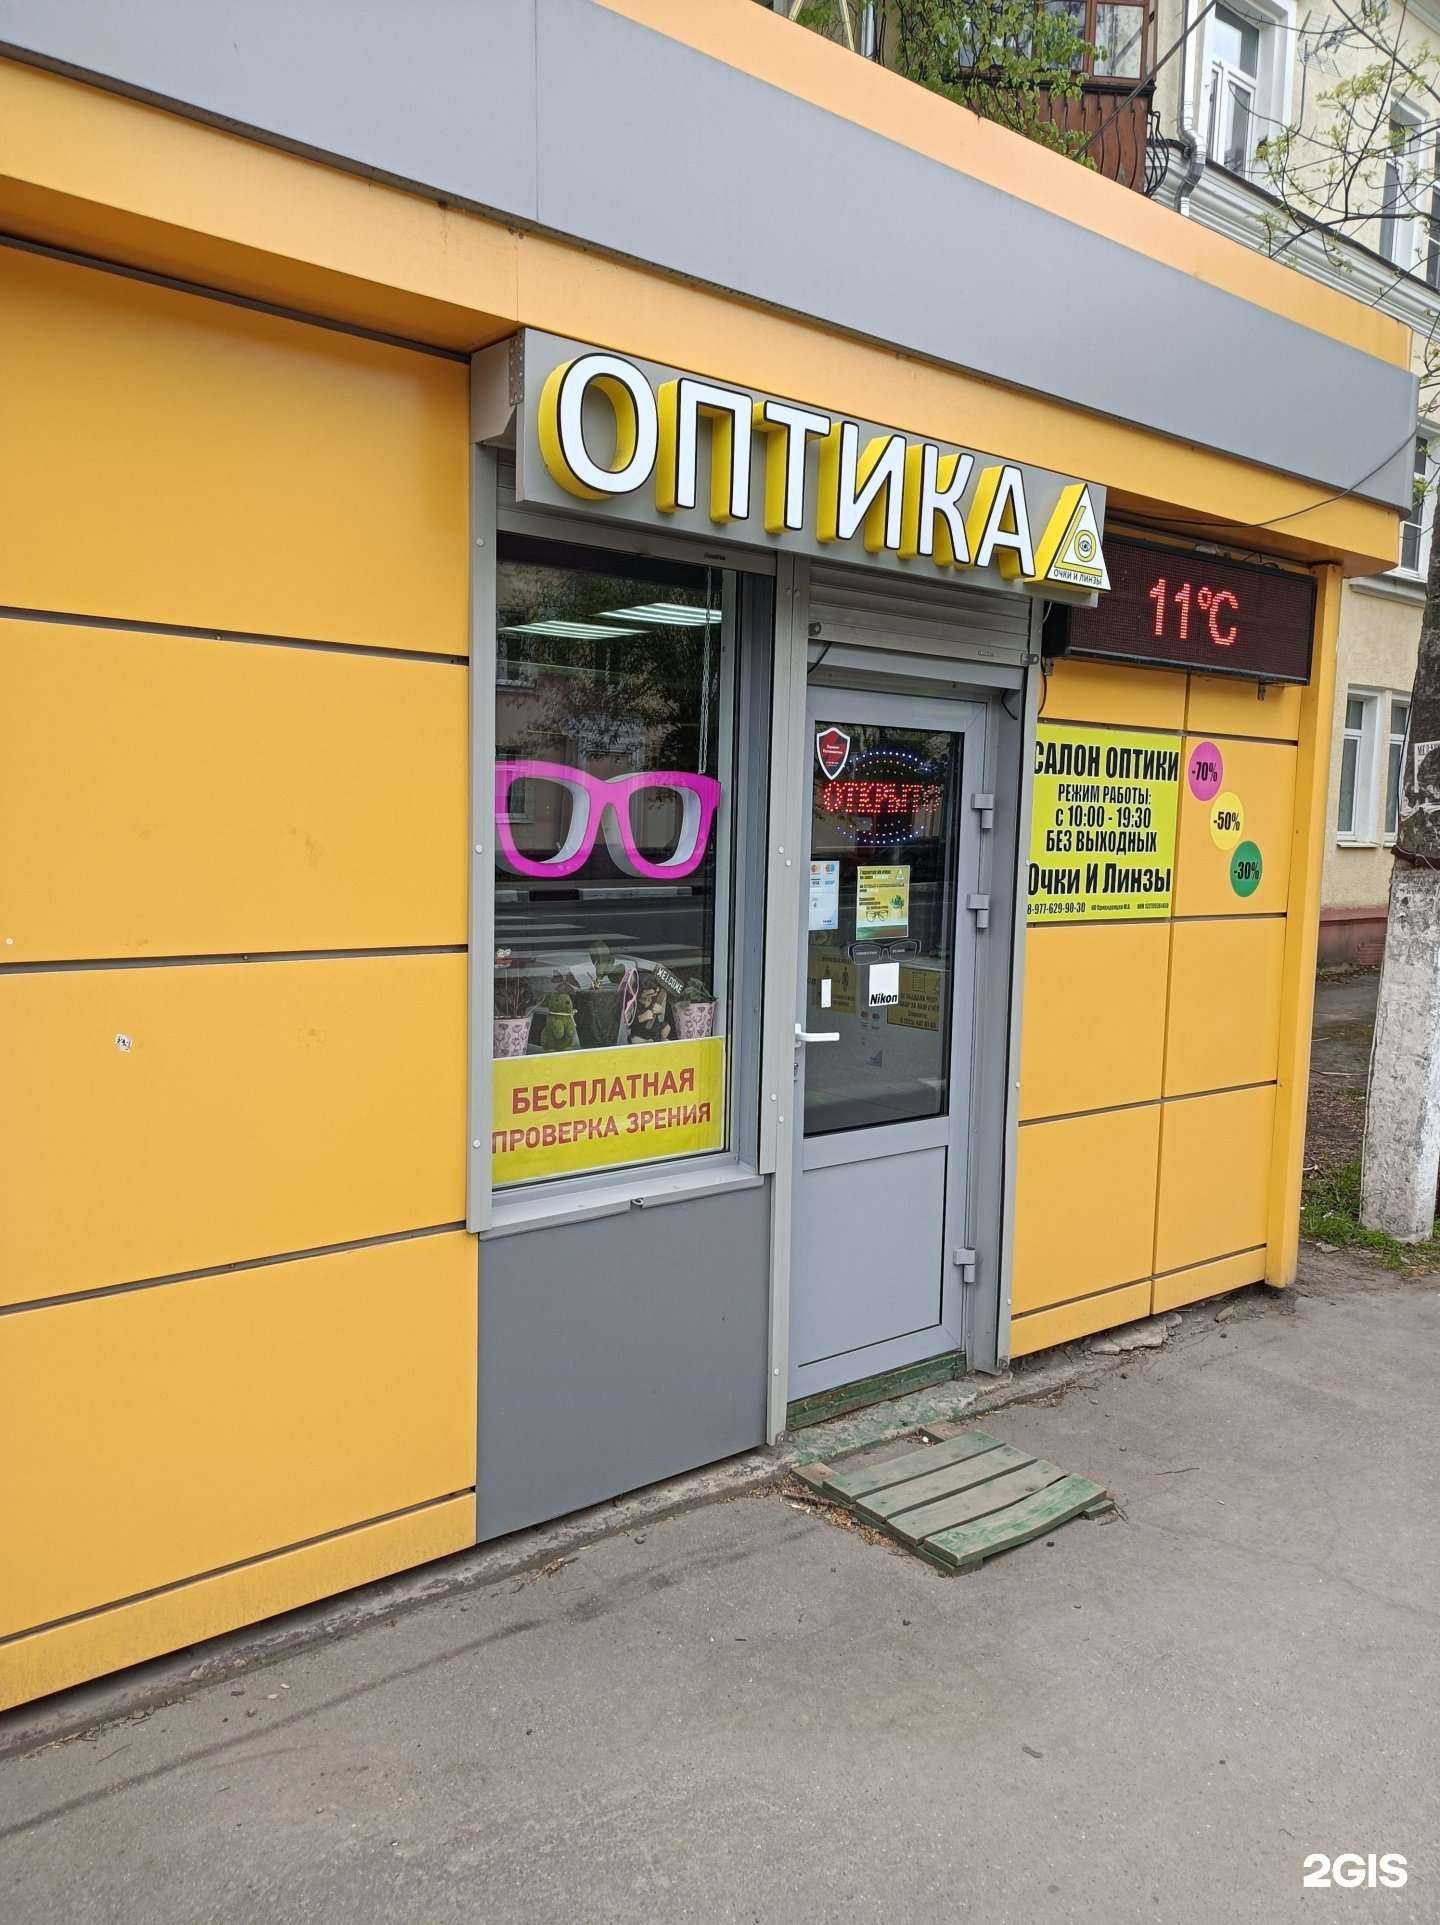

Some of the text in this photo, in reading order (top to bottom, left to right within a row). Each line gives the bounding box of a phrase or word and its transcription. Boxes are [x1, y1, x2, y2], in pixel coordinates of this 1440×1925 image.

[553, 352, 1037, 579] ОПТИКА
[1053, 568, 1072, 580] ОЧКИ
[1079, 574, 1103, 586] ЛИНЗЫ
[1034, 740, 1179, 782] САЛОН ОПТИКИ
[1191, 761, 1218, 782] -70%
[1057, 783, 1152, 805] РЕЖИМ РАБОТЫ:
[1067, 805, 1105, 828] 10:00
[1116, 806, 1152, 828] 19:30
[1213, 811, 1240, 832] -50%
[1046, 829, 1157, 855] БЕЗ ВЫХОДНЫХ
[1028, 862, 1171, 896] Очки И Линзы
[1233, 860, 1260, 881] -30%
[656, 967, 684, 994] WELCOME
[870, 993, 898, 1005] Nikon
[511, 1067, 696, 1115] БЕСПЛАТНАЯ
[492, 1102, 712, 1154] ПРОВЕРКА ЗРЕНИЯ
